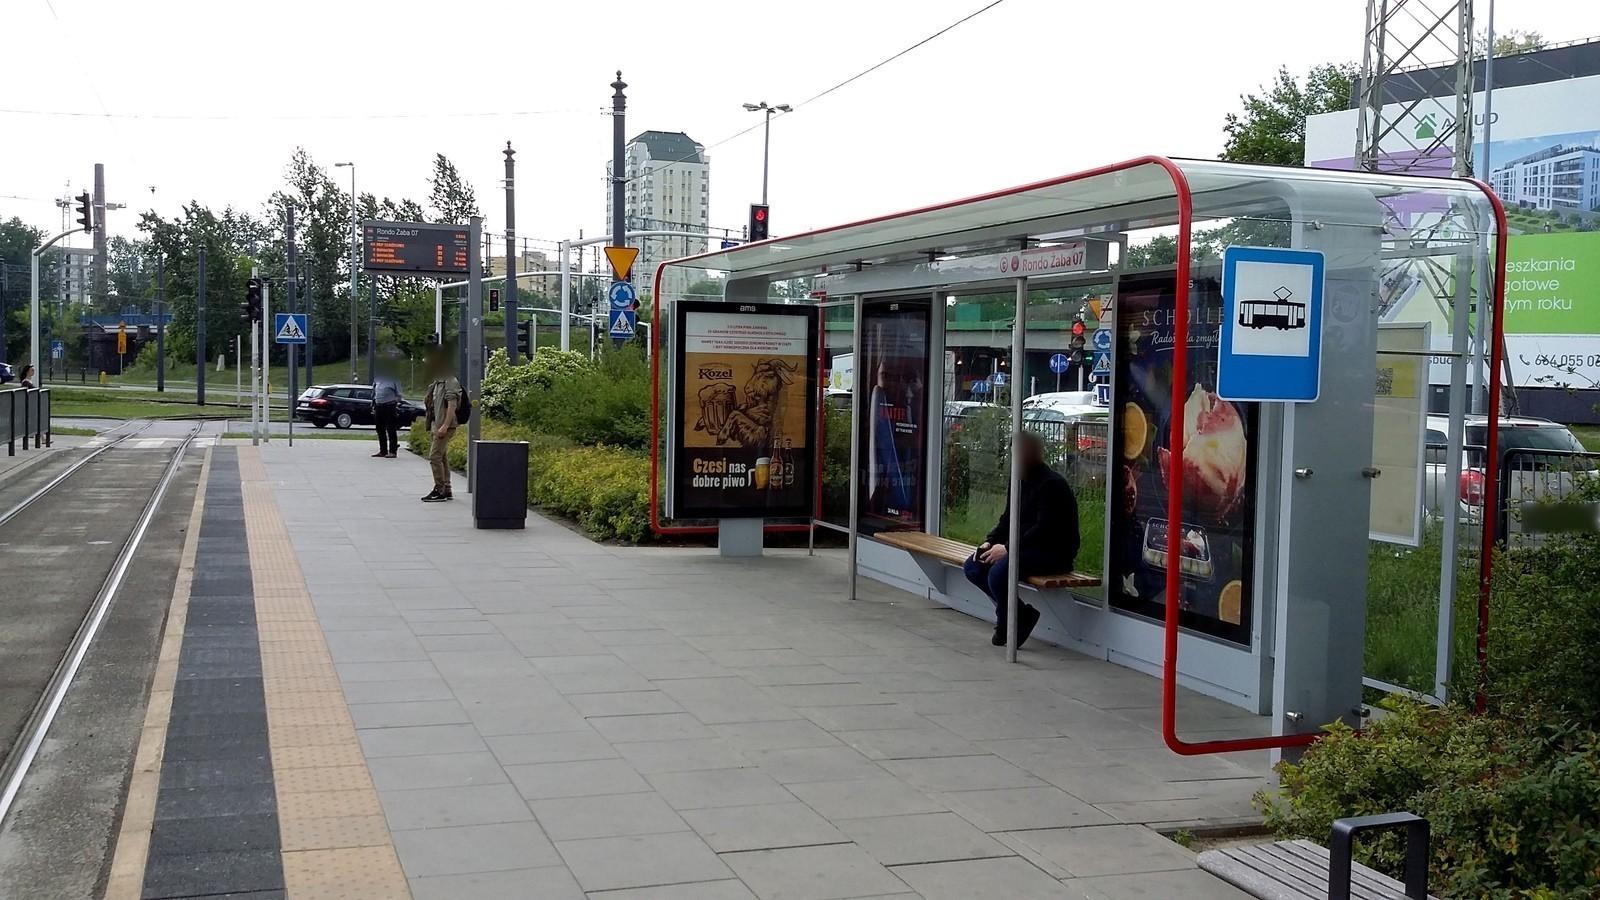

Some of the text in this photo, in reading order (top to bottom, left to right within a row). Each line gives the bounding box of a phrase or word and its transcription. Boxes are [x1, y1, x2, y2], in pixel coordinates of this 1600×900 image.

[1022, 256, 1048, 271] Rondo
[1072, 251, 1084, 265] 07
[1505, 257, 1575, 273] eszkania
[1537, 296, 1572, 310] roku
[1560, 354, 1583, 367] 055
[699, 368, 733, 380] Kozel
[693, 457, 747, 474] Czesi nas
[692, 474, 746, 490] dobre piwo
